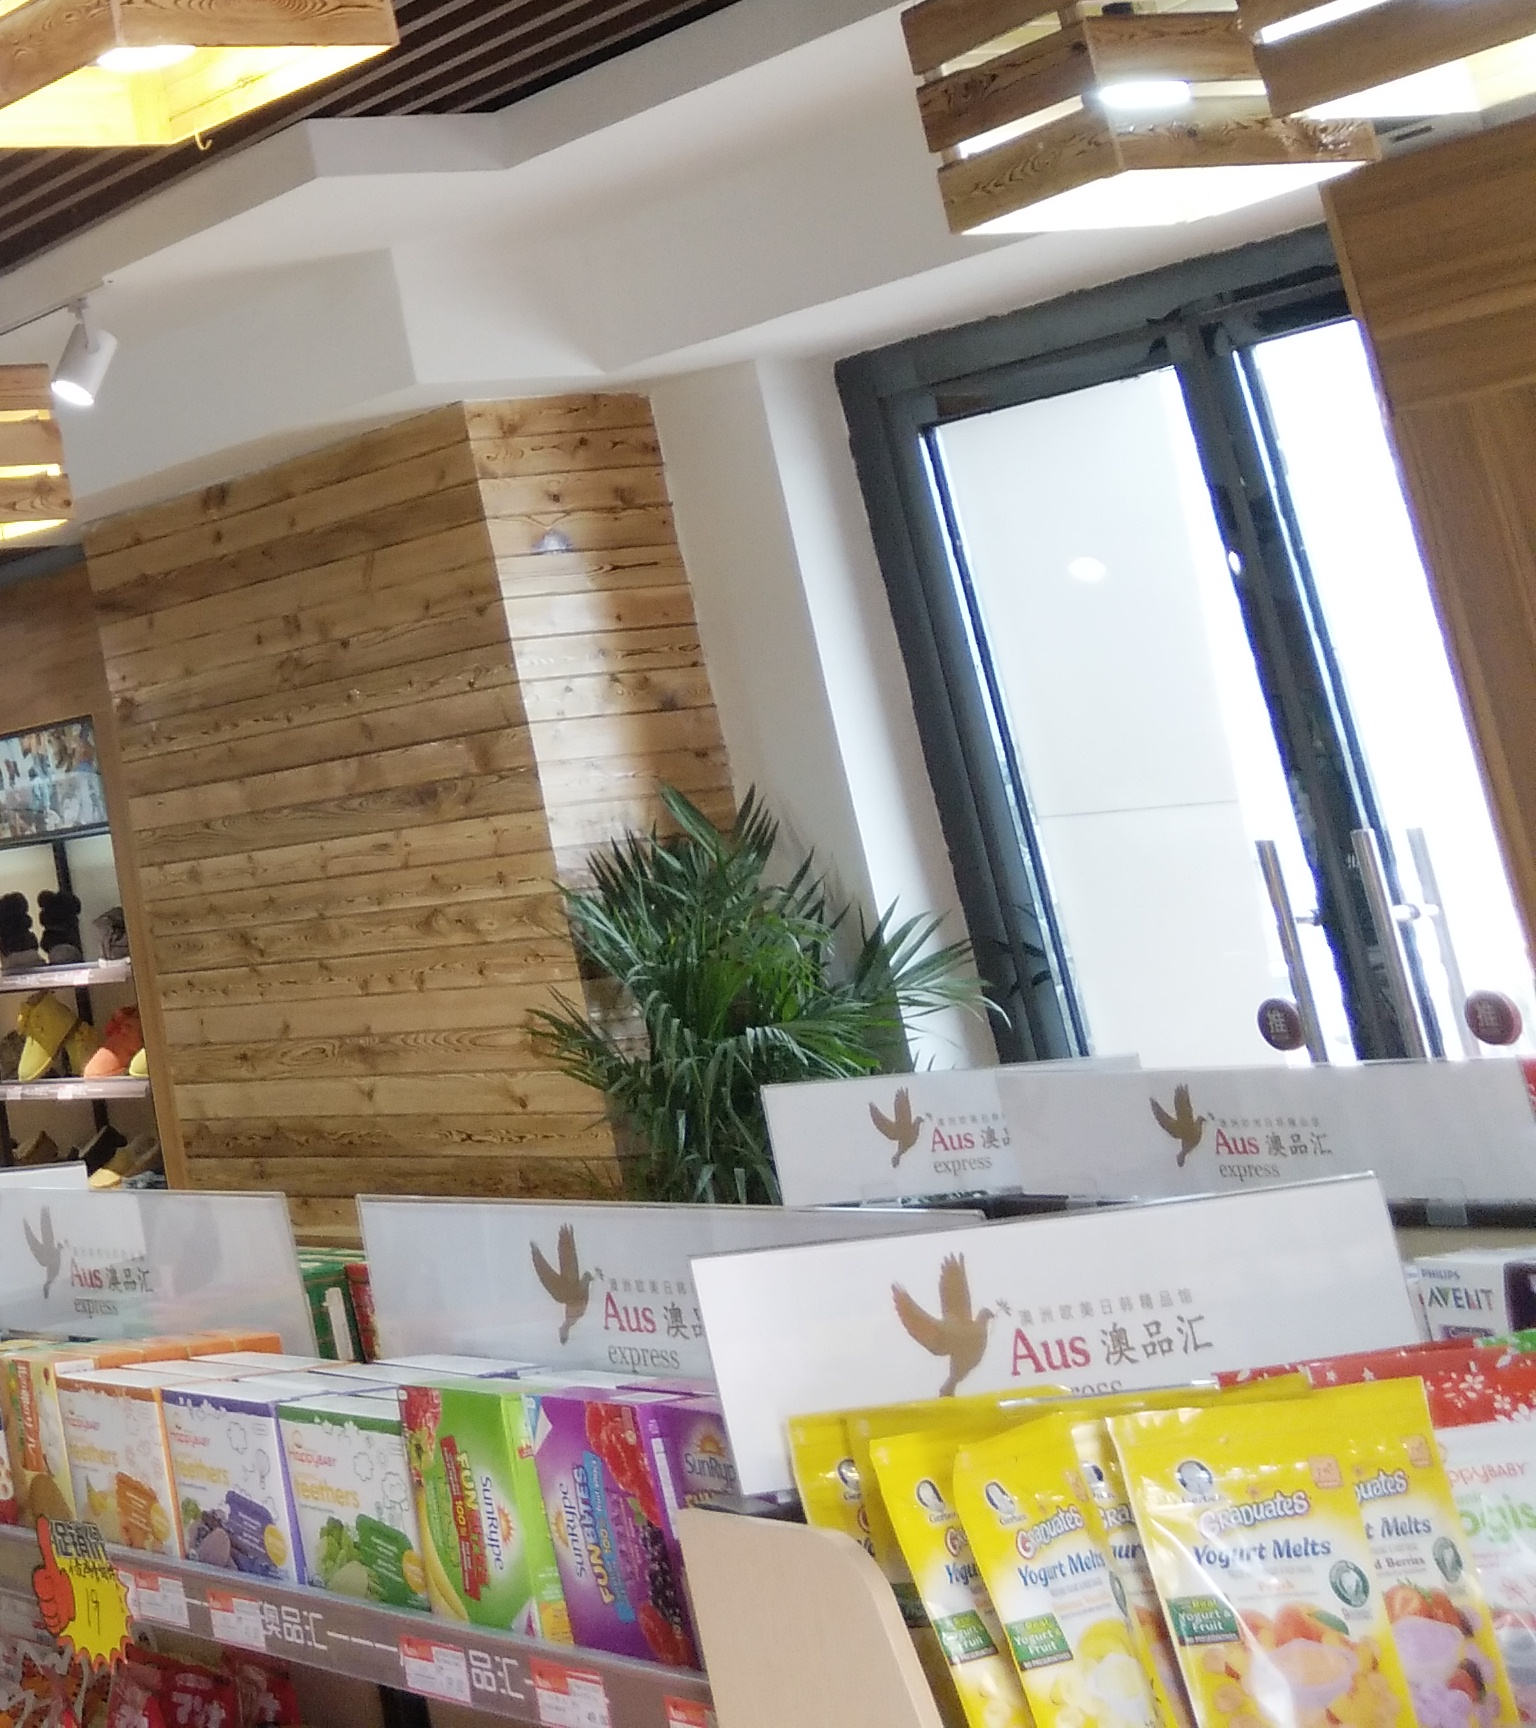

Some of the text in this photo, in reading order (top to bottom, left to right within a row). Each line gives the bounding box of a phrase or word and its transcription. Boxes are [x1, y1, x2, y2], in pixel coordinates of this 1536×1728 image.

[931, 1127, 974, 1152] Aus
[1214, 1128, 1332, 1159] Aus 澳品汇
[933, 1157, 992, 1176] express
[1218, 1161, 1280, 1180] express
[70, 1258, 104, 1289] Aus
[73, 1297, 119, 1320] express
[1428, 1285, 1494, 1311] AVENT
[603, 1290, 658, 1334] Aus
[1011, 1313, 1214, 1377] Aus 澳品汇
[608, 1345, 681, 1374] express
[479, 1475, 504, 1571] SunRype
[558, 1482, 587, 1578] SunRype
[1381, 1515, 1432, 1539] Melts
[1272, 1536, 1332, 1560] Melts
[1017, 1559, 1067, 1587] Yogurt
[1067, 1549, 1106, 1576] Melts
[1385, 1555, 1426, 1568] Berries
[945, 1563, 978, 1585] Yogu
[1179, 1609, 1222, 1624] Yogurt
[1192, 1620, 1225, 1633] Fruit
[1014, 1629, 1055, 1646] Yogurt
[1028, 1640, 1058, 1656] Fruit
[467, 1648, 525, 1700] 品汇
